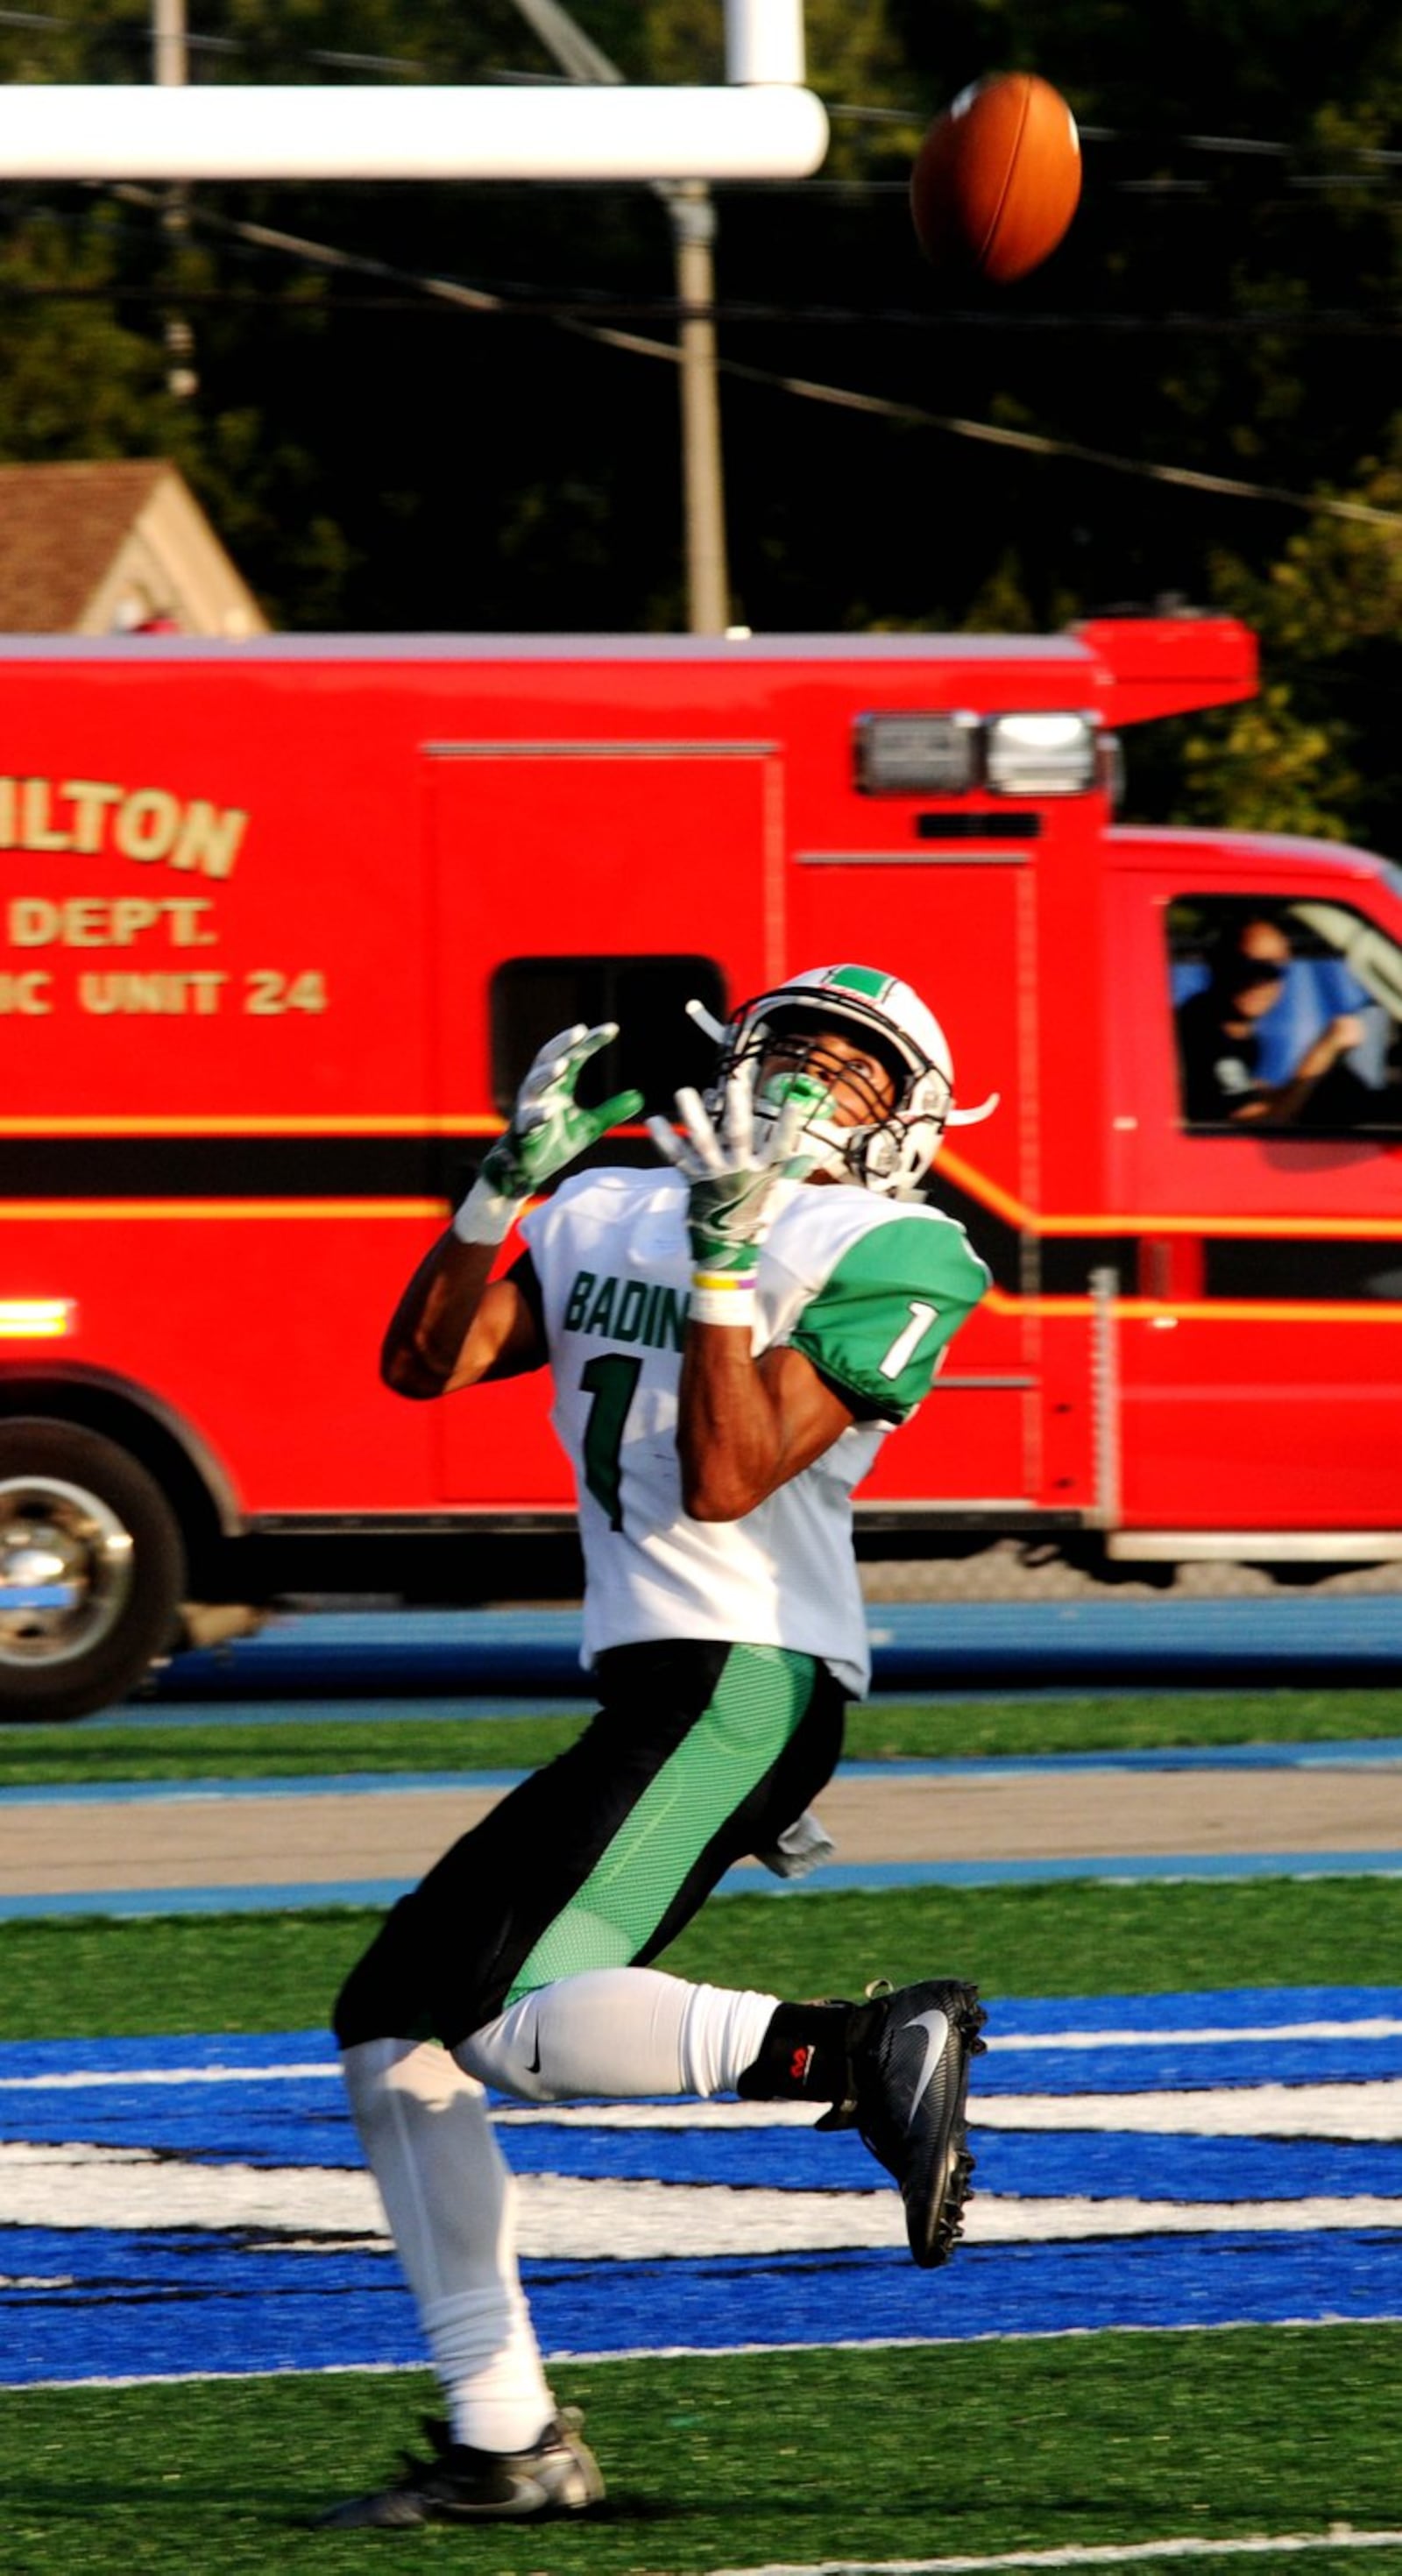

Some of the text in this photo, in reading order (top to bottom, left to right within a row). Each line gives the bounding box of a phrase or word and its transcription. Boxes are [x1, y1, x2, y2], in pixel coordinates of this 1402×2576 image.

[0, 776, 250, 880] ILTON
[10, 897, 217, 947] DEPT.
[78, 971, 227, 1016] UNIT
[244, 969, 328, 1016] 24
[563, 1270, 690, 1354] BADIN
[877, 1300, 941, 1382] 1
[579, 1352, 643, 1532] 1
